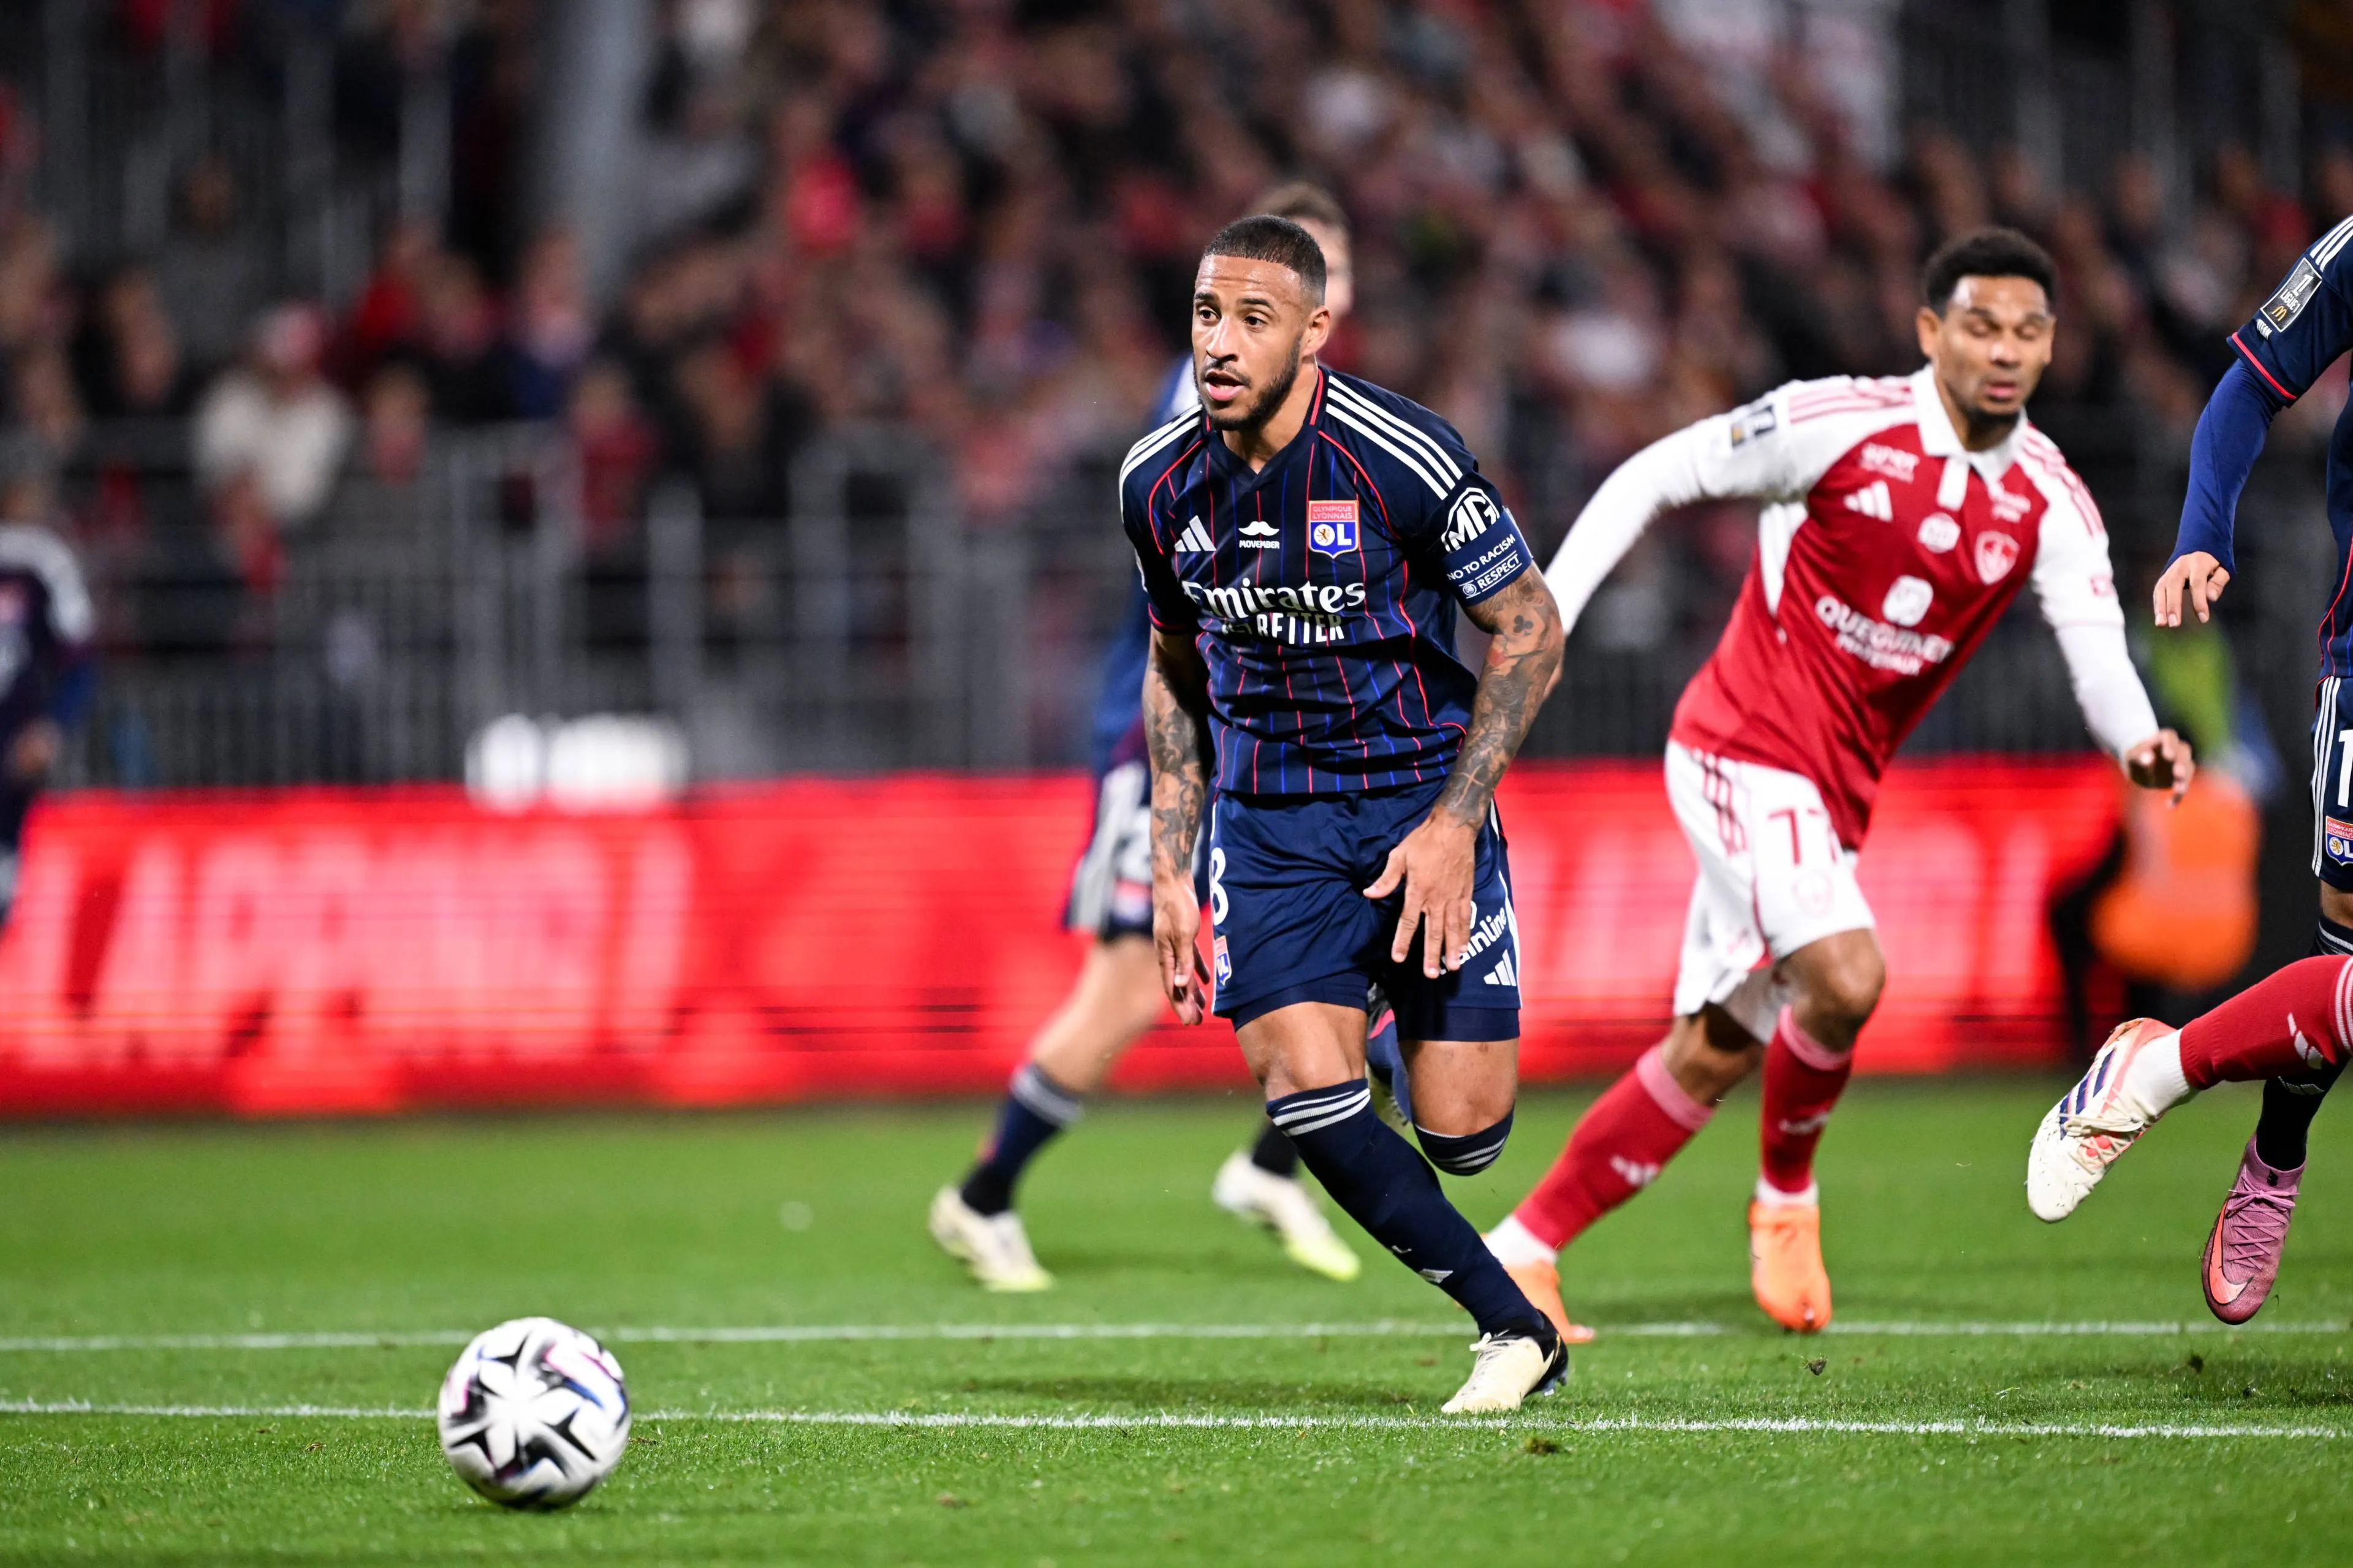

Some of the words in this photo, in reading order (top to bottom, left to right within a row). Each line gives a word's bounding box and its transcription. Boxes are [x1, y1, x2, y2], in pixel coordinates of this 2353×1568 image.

[1239, 540, 1280, 549] MOVEMBER
[1448, 494, 1497, 551] MG
[1447, 570, 1464, 580] NO
[1463, 561, 1480, 574] TO
[1479, 534, 1516, 566] RACISM
[1477, 553, 1520, 589] RESPECT
[1181, 577, 1366, 619] Emirates
[1439, 907, 1507, 975] ainline
